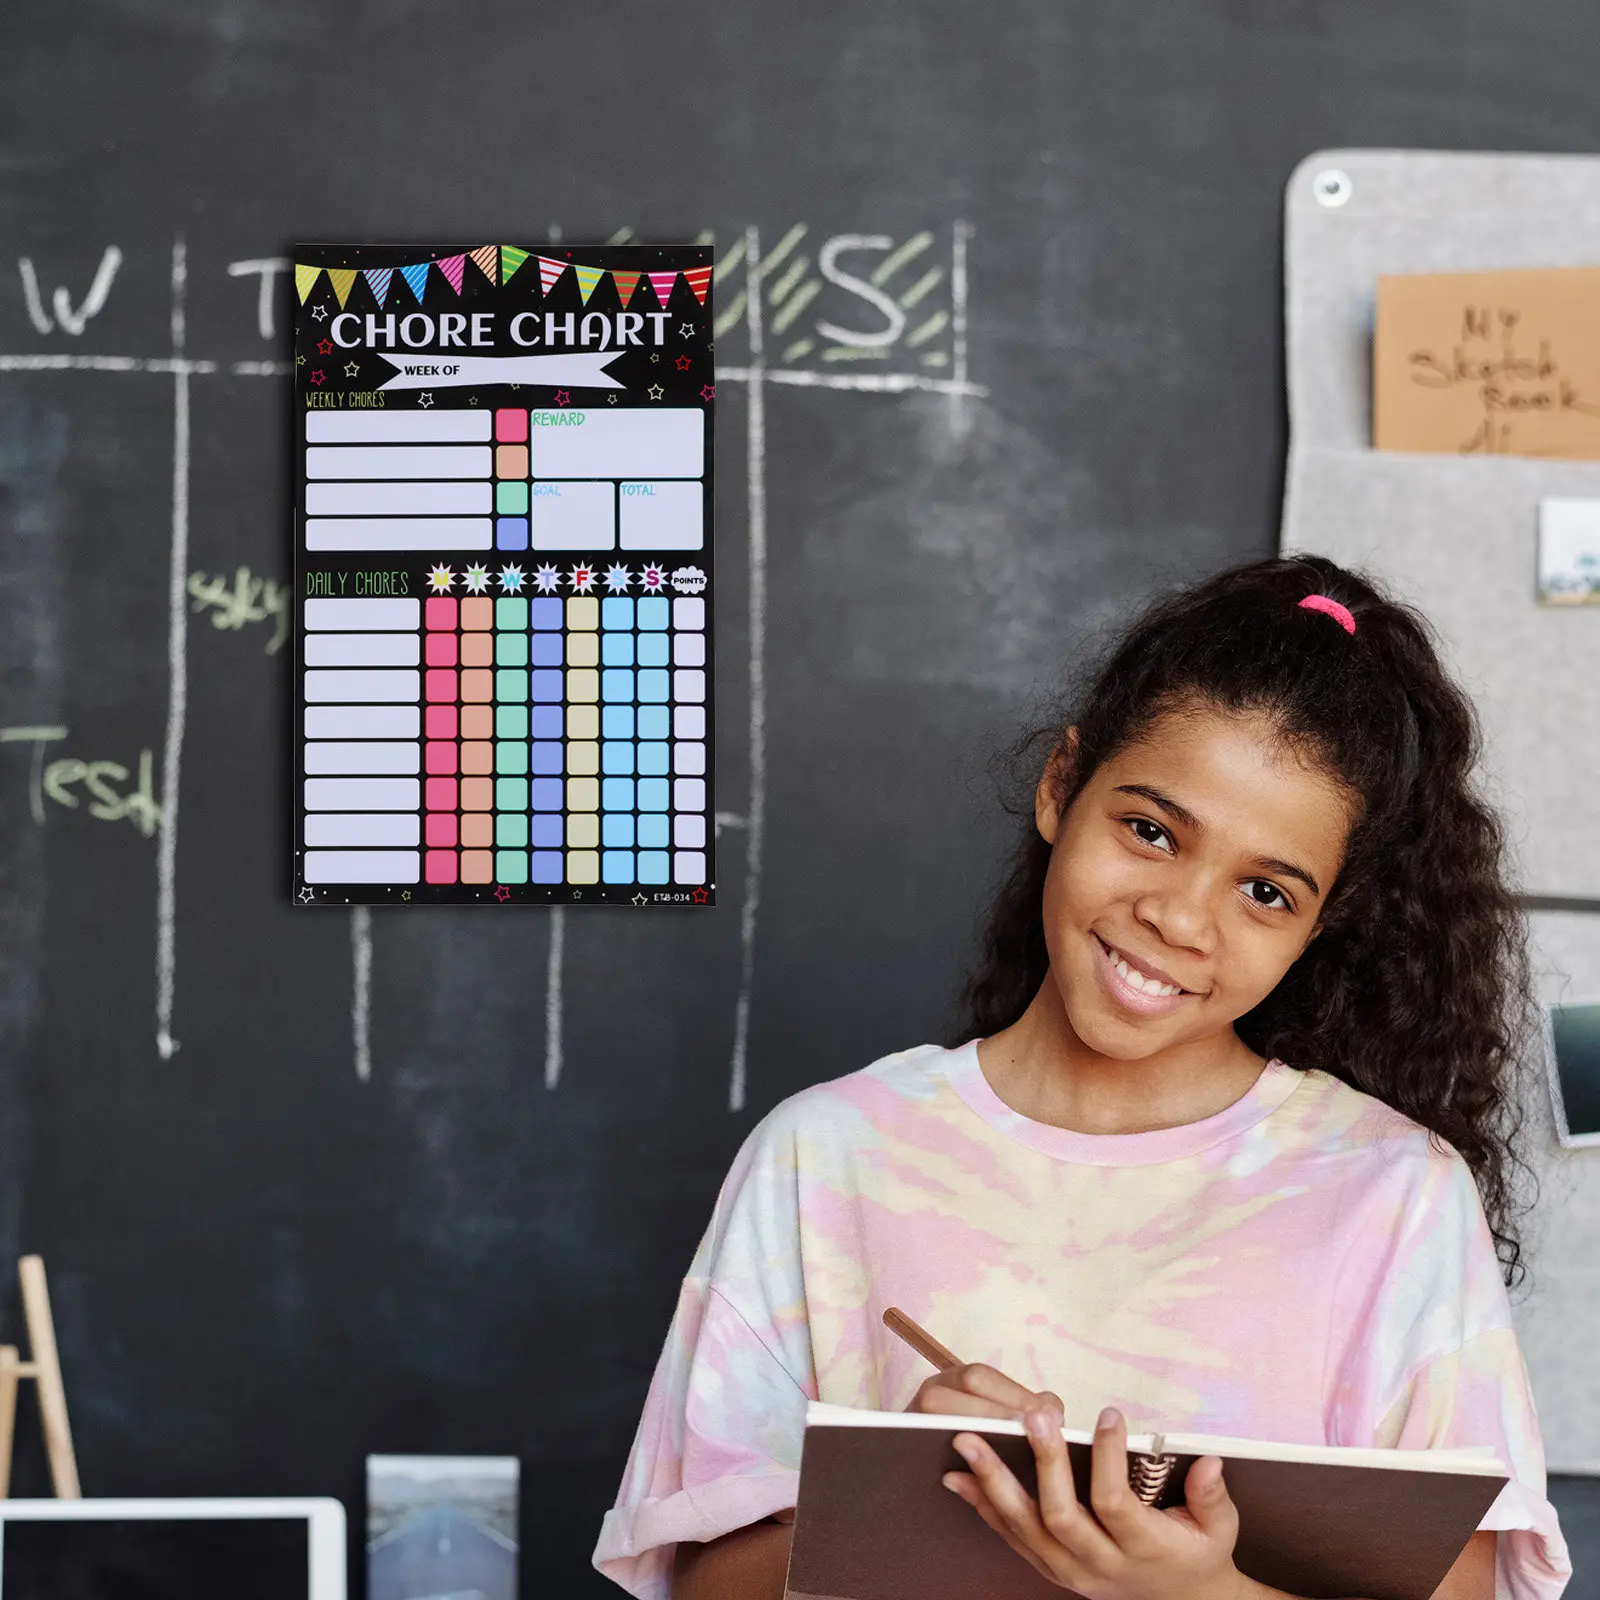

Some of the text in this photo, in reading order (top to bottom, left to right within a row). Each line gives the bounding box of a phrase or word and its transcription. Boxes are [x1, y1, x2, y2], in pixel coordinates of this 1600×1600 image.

[18, 245, 122, 335] W
[815, 233, 906, 347] S
[330, 311, 672, 352] CHORE CHART
[404, 365, 460, 376] WEEK OF
[305, 391, 385, 408] WEEKLY CHORES
[532, 412, 585, 426] REWARD
[533, 485, 561, 496] GOAL
[620, 484, 656, 496] TOTAL
[306, 571, 409, 595] DAILY CHORES
[434, 570, 704, 588] M T W T F S S POINTS
[653, 893, 690, 901] ETB-034
